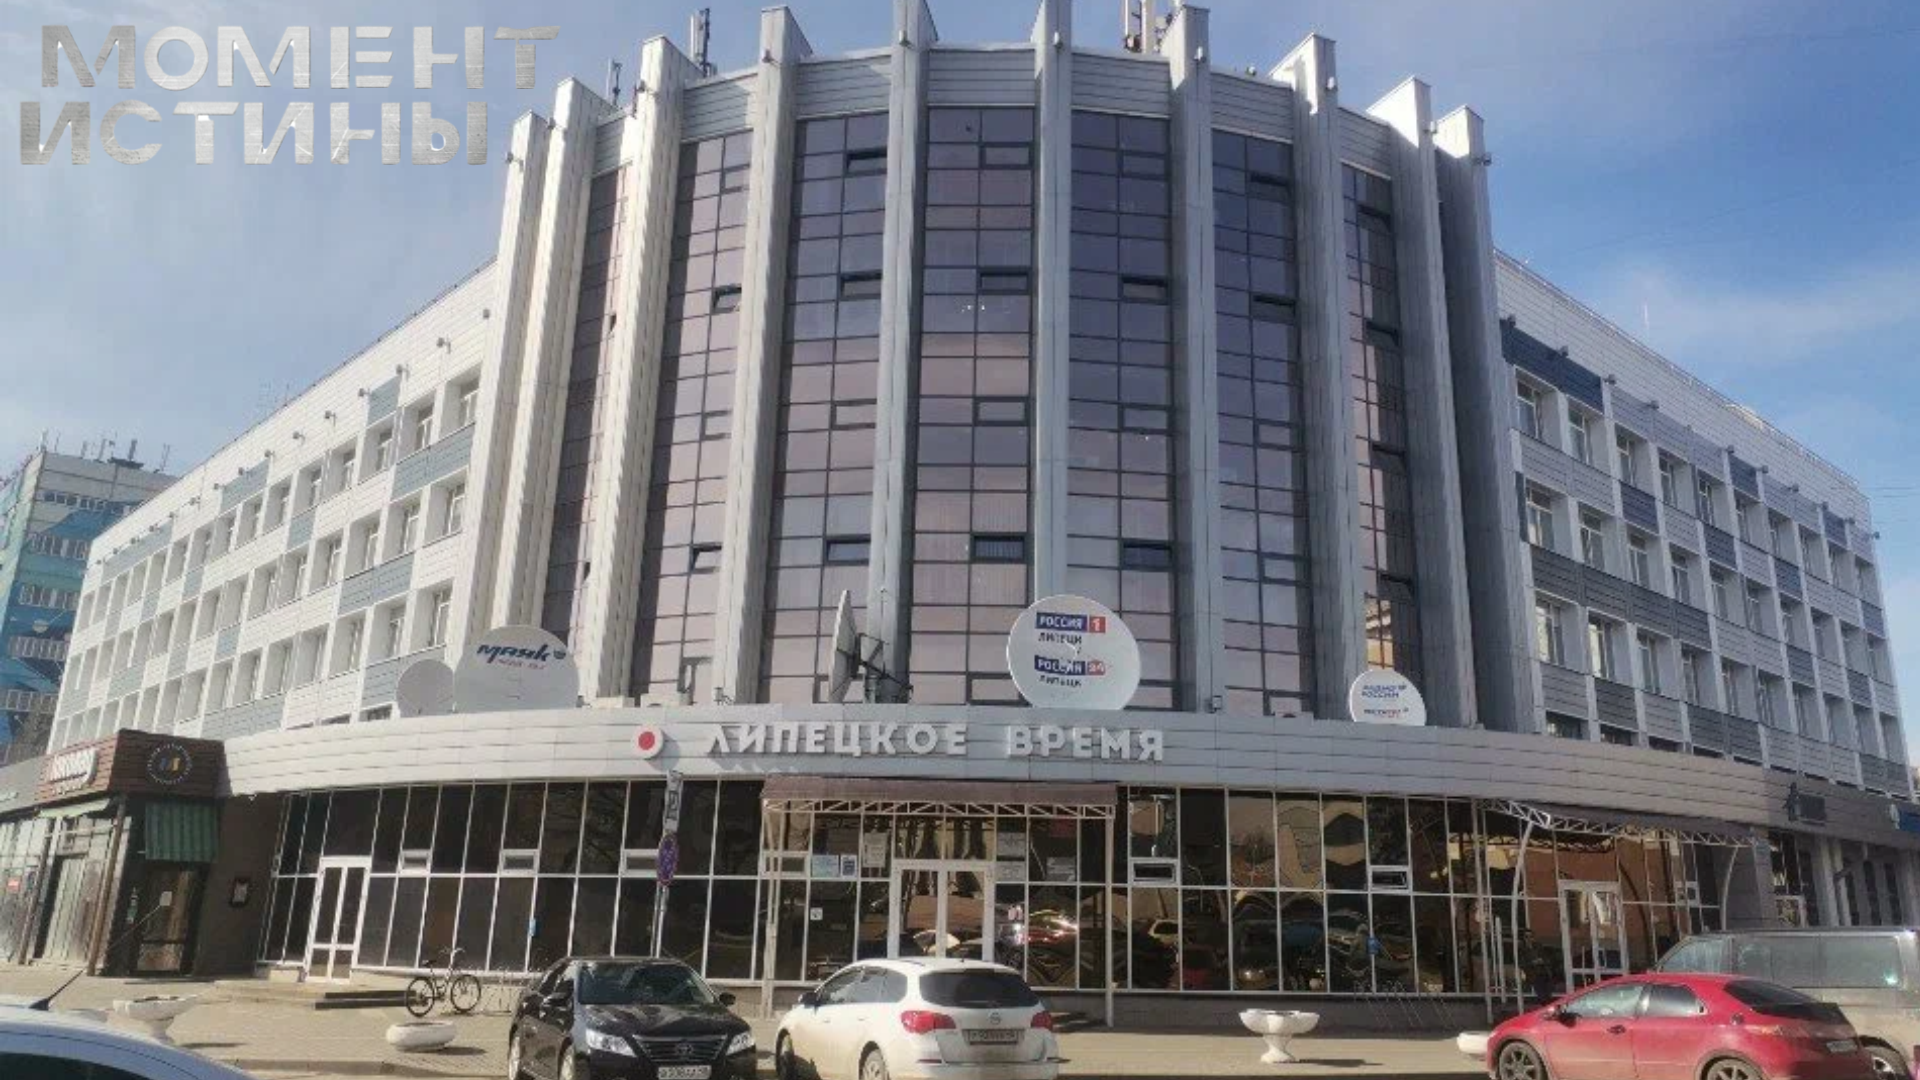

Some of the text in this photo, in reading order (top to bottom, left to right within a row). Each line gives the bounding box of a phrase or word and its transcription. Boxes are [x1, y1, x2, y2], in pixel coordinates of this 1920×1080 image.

[1092, 617, 1101, 632] 1
[705, 722, 1164, 761] ЛИПЕЦКОЕ ВРЕМЯ
